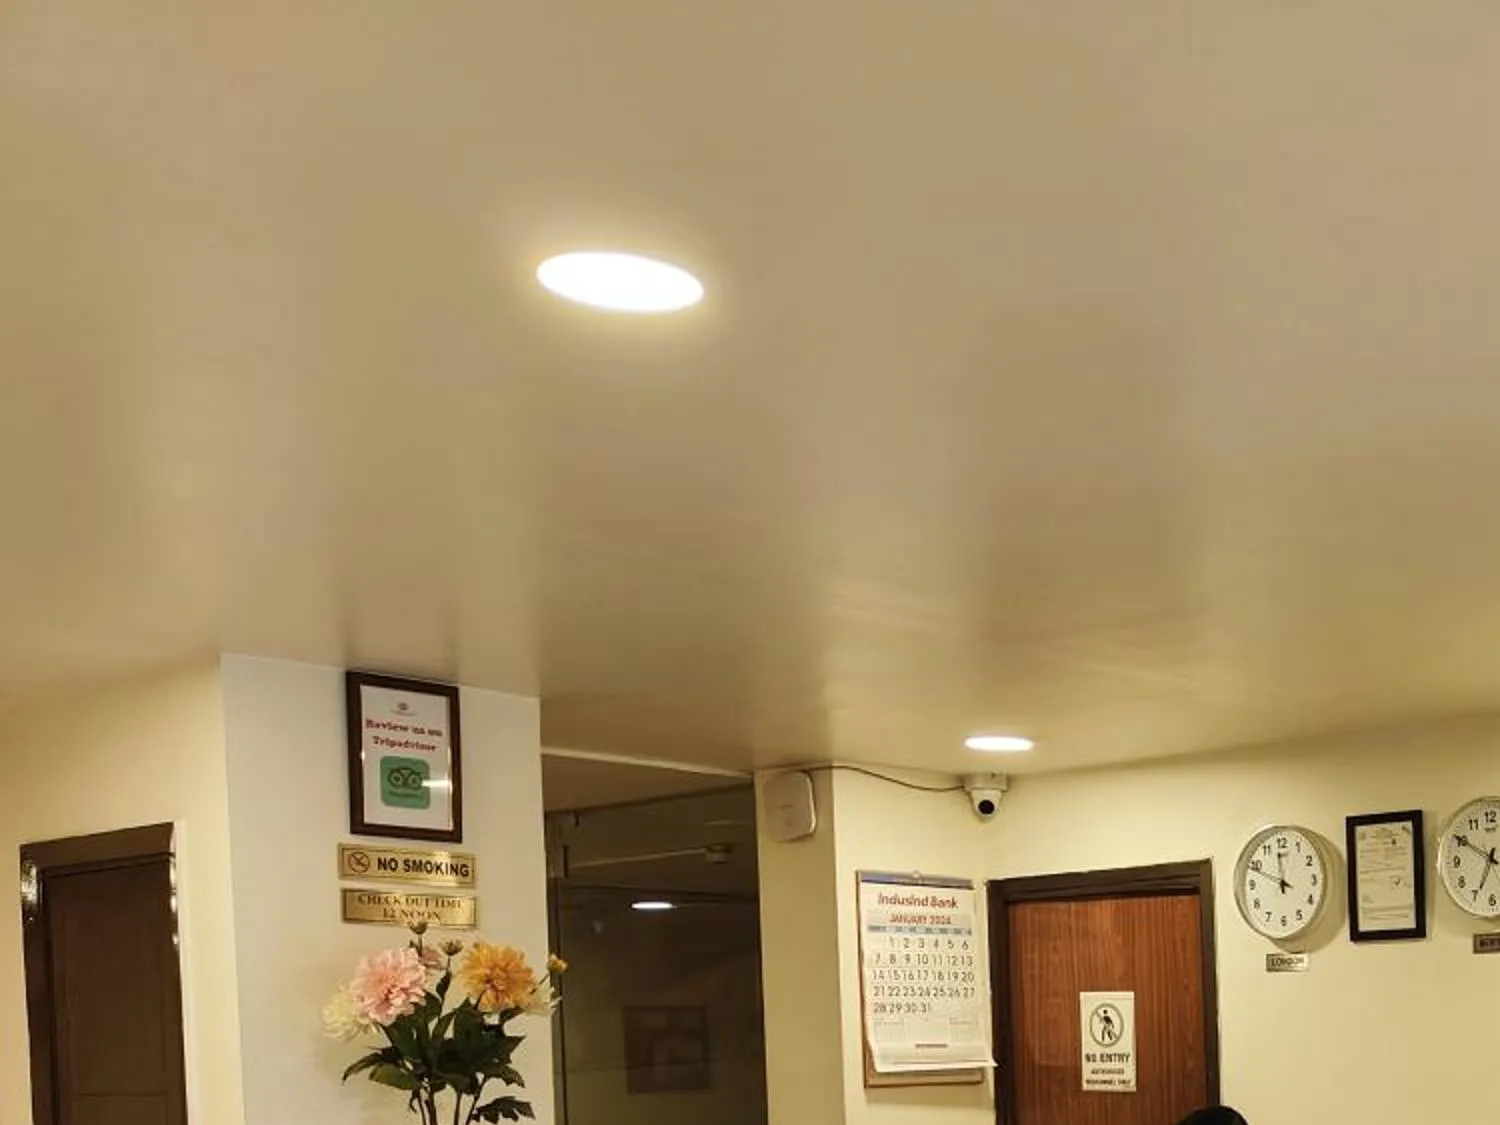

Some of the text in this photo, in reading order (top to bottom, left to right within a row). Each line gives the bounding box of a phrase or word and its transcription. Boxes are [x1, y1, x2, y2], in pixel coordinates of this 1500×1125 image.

[1484, 811, 1496, 823] 12
[1468, 819, 1479, 830] 11
[1277, 838, 1287, 849] 12
[1296, 842, 1301, 852] 1
[1263, 845, 1271, 855] 11
[1306, 856, 1313, 866] 2
[1454, 856, 1461, 868] 9
[377, 857, 469, 877] NO SMOKING
[1249, 880, 1256, 890] 9
[1311, 875, 1317, 886] 3
[1458, 876, 1465, 888] 8
[358, 895, 400, 905] CHECK
[405, 897, 429, 907] OUT
[1307, 894, 1314, 905] 4
[1472, 890, 1479, 901] 7
[1489, 894, 1496, 906] 6
[930, 896, 958, 909] Bank
[1254, 898, 1260, 909] 8
[383, 907, 440, 920] 12 NOON
[1265, 912, 1272, 922] 7
[1296, 909, 1303, 920] 5
[1281, 916, 1287, 926] 6
[889, 936, 968, 950] 1 2 3 4 5 6
[889, 953, 897, 964] 8
[917, 954, 928, 965] 10
[932, 954, 942, 965] 11
[946, 955, 958, 966] 12
[961, 956, 973, 966] 13
[873, 970, 975, 982] 14 15 16 17 18 19 20
[873, 985, 885, 997] 21
[888, 985, 900, 997] 22
[903, 986, 916, 997] 23
[918, 986, 931, 997] 24
[933, 987, 945, 997] 25
[963, 987, 975, 997] 27
[889, 1002, 902, 1013] 29
[920, 1003, 931, 1013] 31
[1085, 1053, 1130, 1063] NO ENTRY
